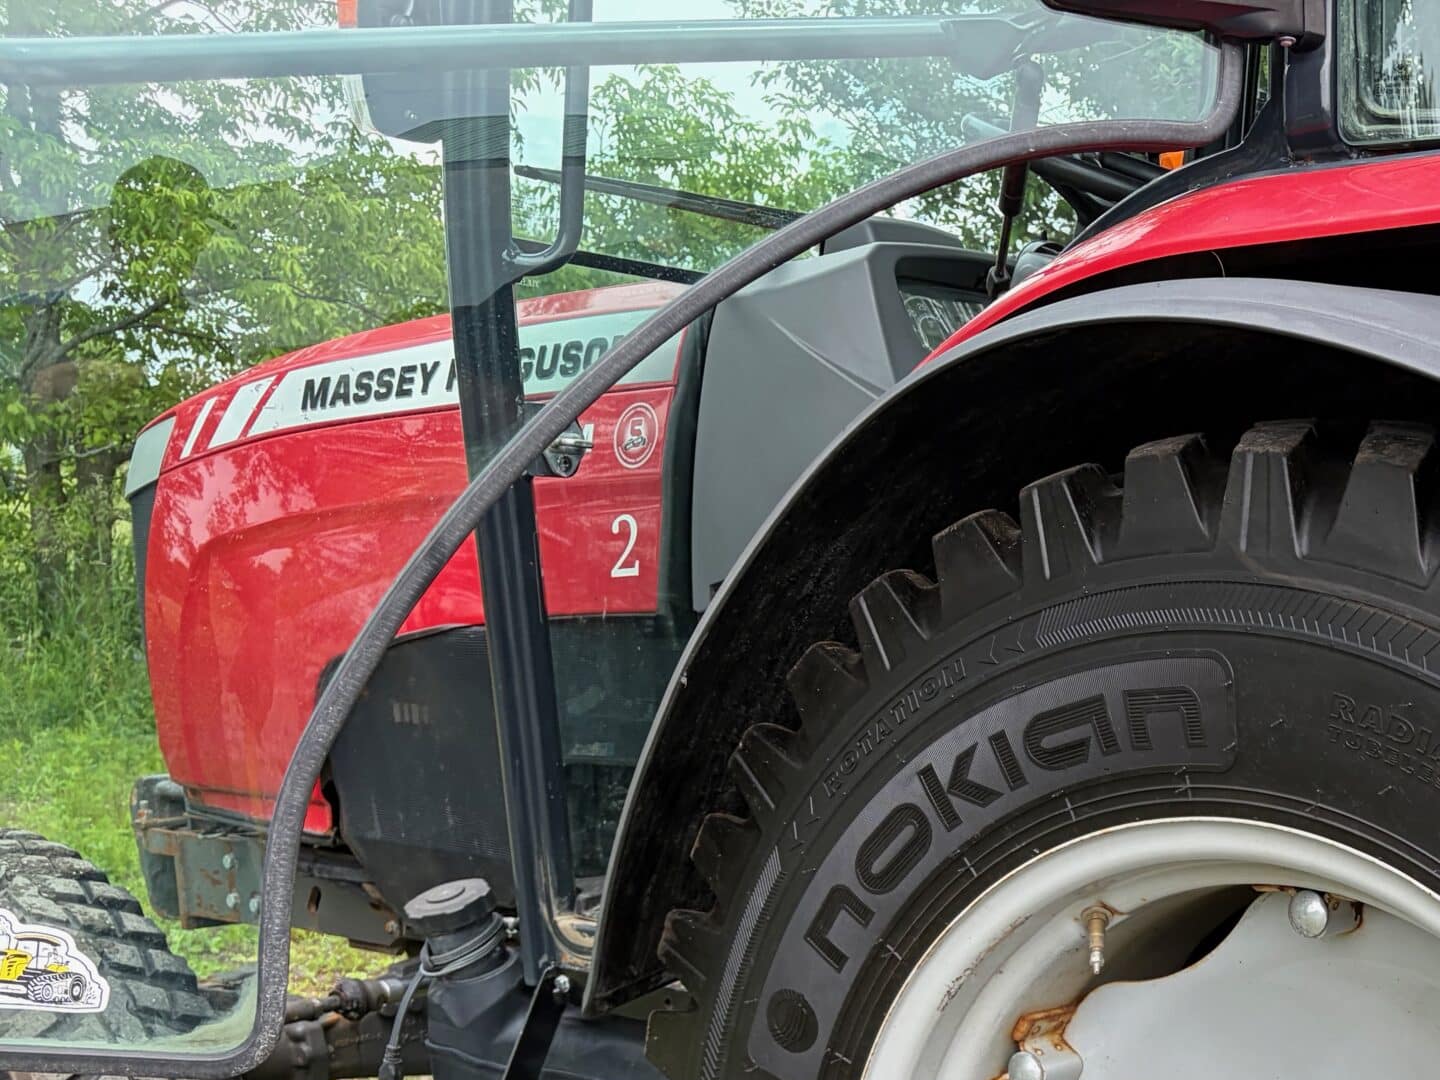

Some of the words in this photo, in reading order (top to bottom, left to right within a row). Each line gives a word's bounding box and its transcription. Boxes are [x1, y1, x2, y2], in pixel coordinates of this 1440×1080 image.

[300, 360, 441, 412] MASSEY
[445, 333, 628, 395] GUSO
[611, 513, 640, 578] 2
[822, 656, 968, 799] ROTATION
